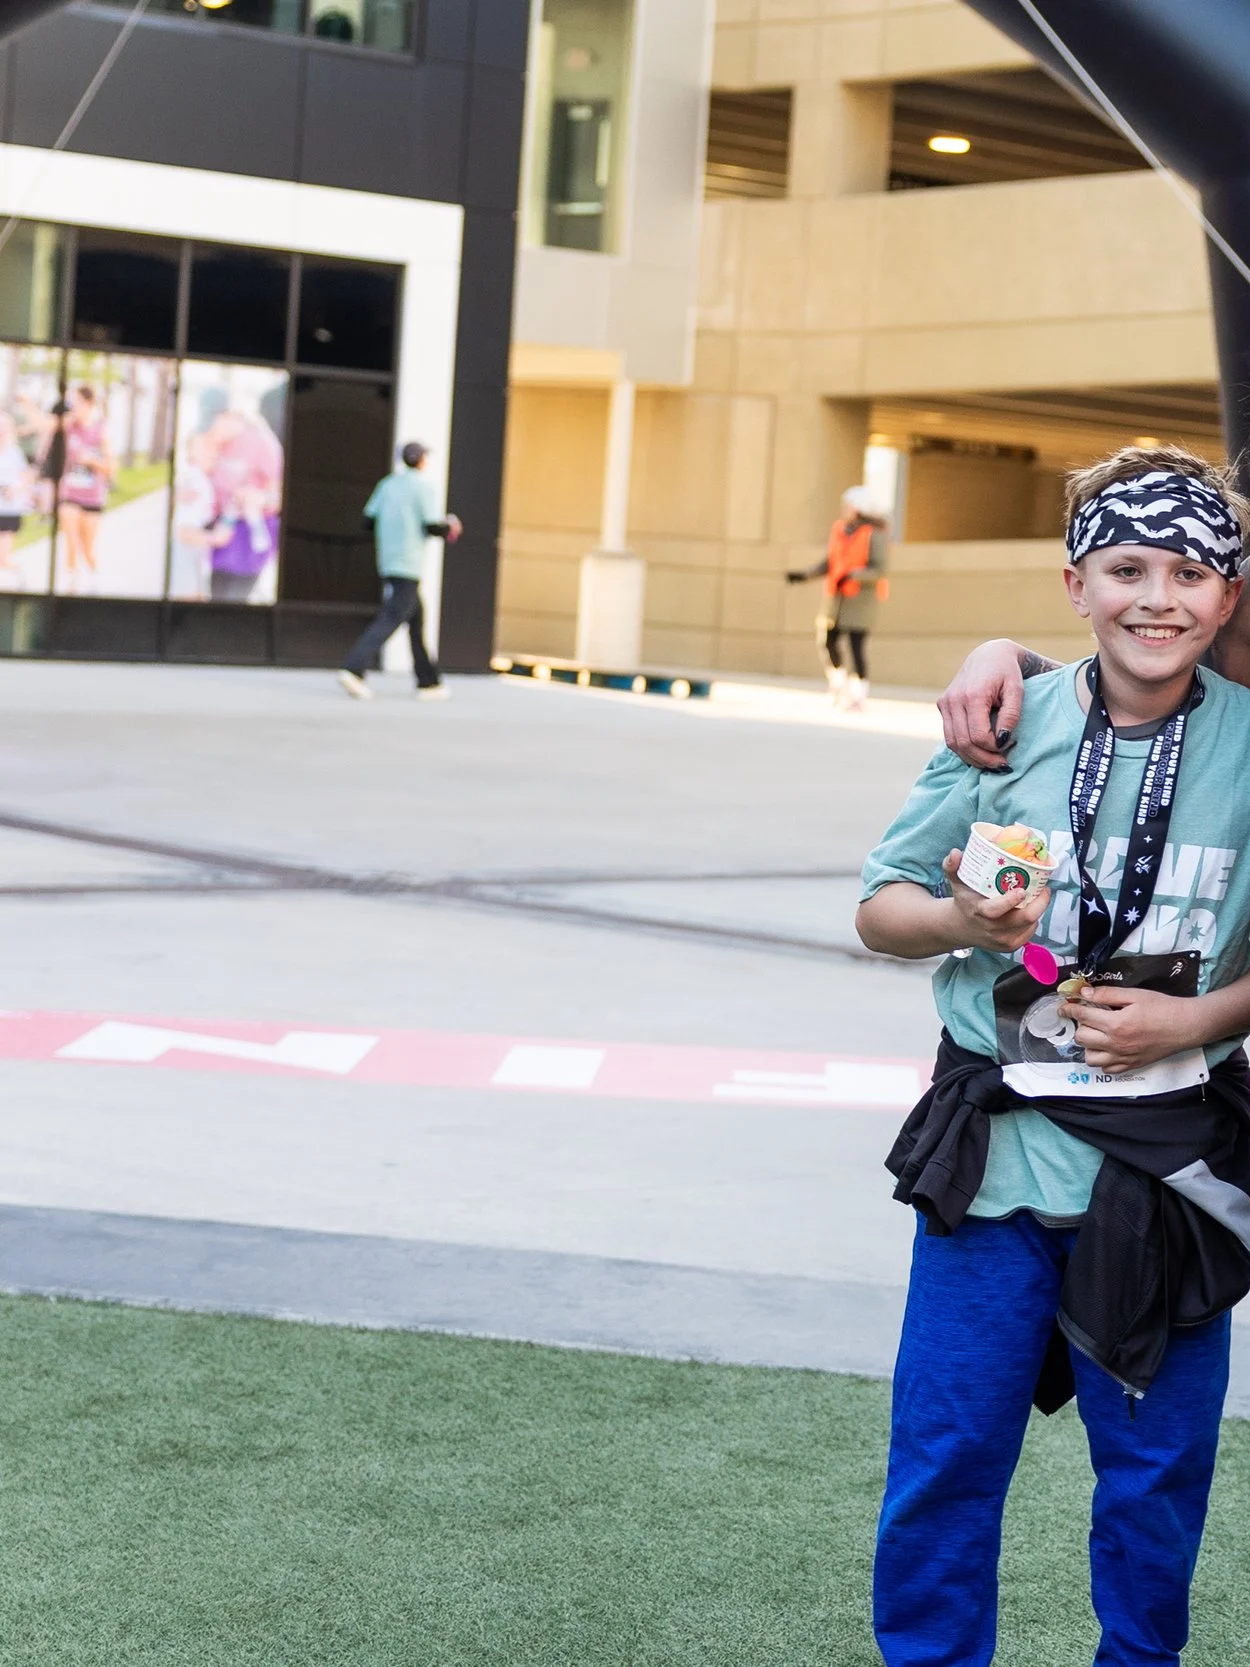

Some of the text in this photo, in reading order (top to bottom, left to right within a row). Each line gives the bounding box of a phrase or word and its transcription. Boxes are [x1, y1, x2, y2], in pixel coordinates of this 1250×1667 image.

[1071, 740, 1093, 833] FIND YOUR KIND
[1082, 763, 1098, 795] YOUR
[1090, 731, 1105, 762] KIND
[1087, 727, 1114, 815] FIND YOUR KIND
[1136, 735, 1164, 825] FIND YOUR KIND
[1148, 722, 1175, 817] FIND YOUR KIND
[1160, 715, 1185, 807] FIND YOUR KIND
[1015, 822, 1238, 900] RAVE
[1048, 889, 1217, 957] KND
[1095, 1074, 1113, 1083] ND
